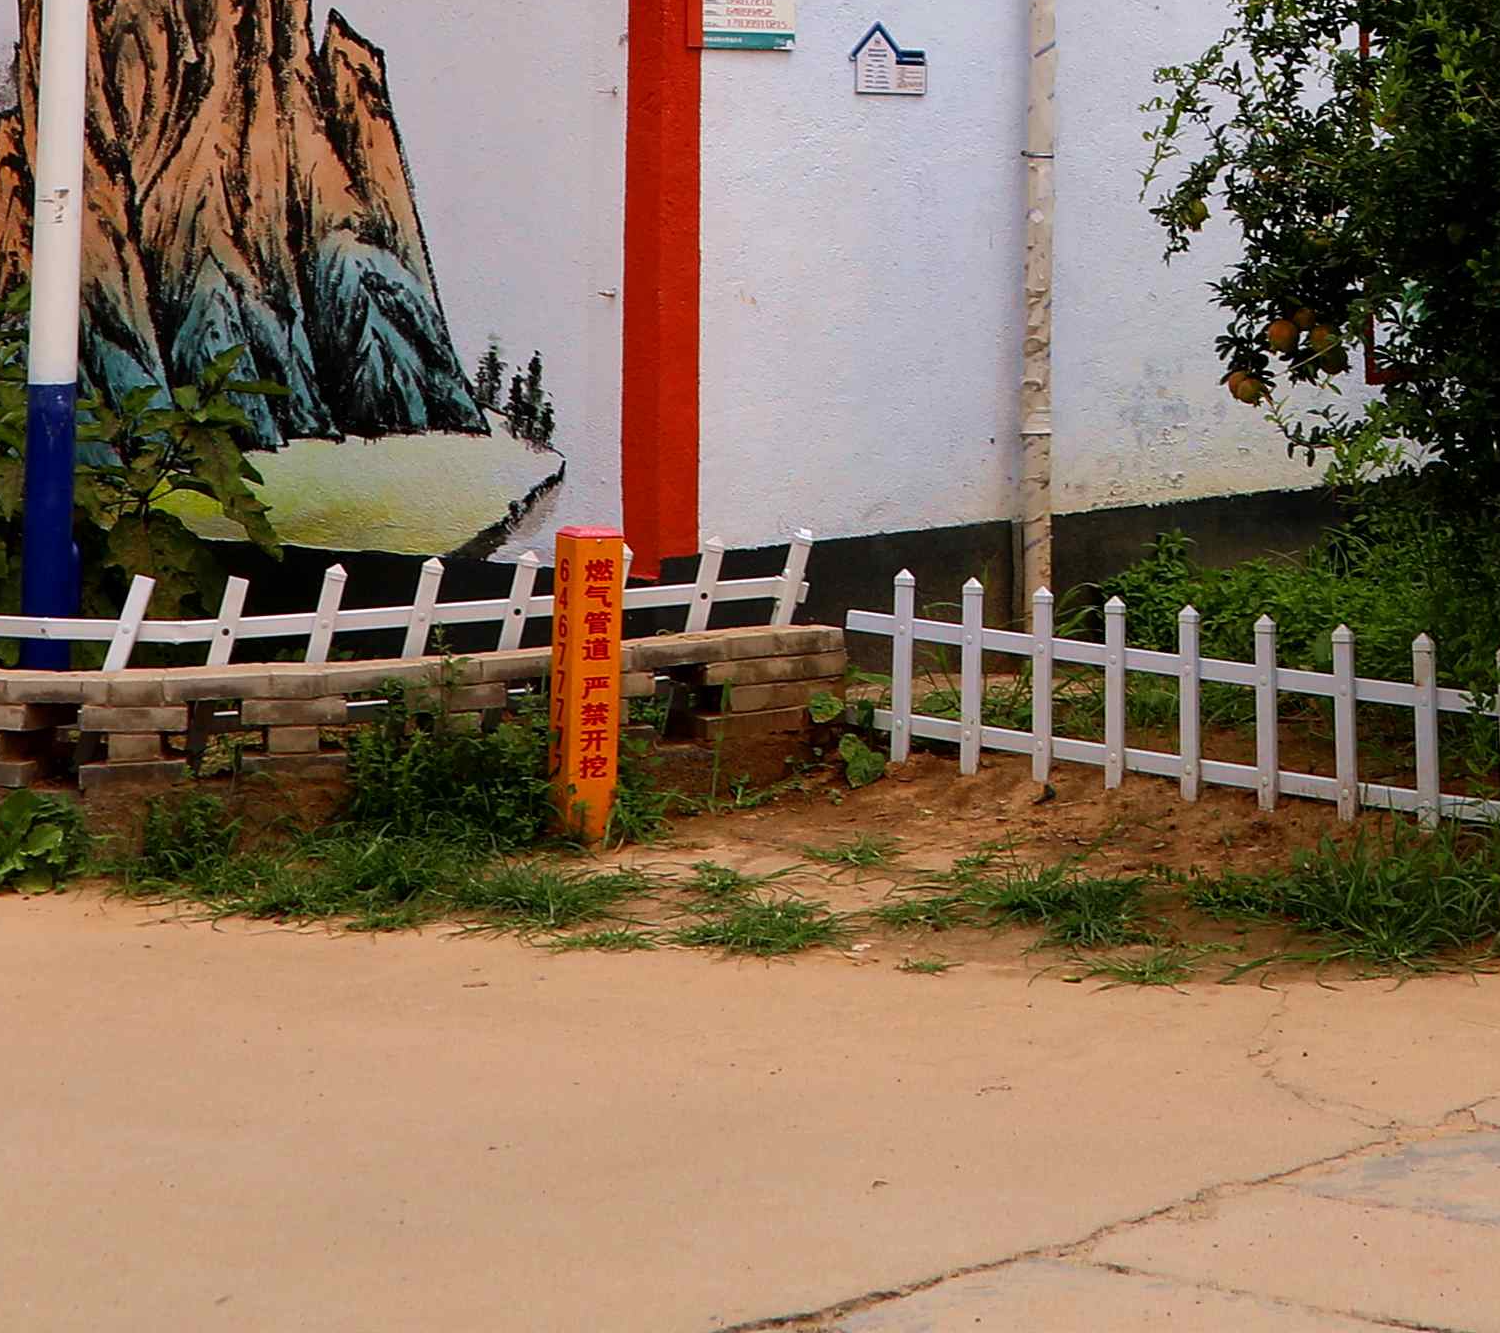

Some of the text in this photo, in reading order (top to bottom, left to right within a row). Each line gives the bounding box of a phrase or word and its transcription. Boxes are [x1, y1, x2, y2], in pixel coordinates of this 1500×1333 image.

[579, 558, 615, 780] 燃气管道 严禁开挖
